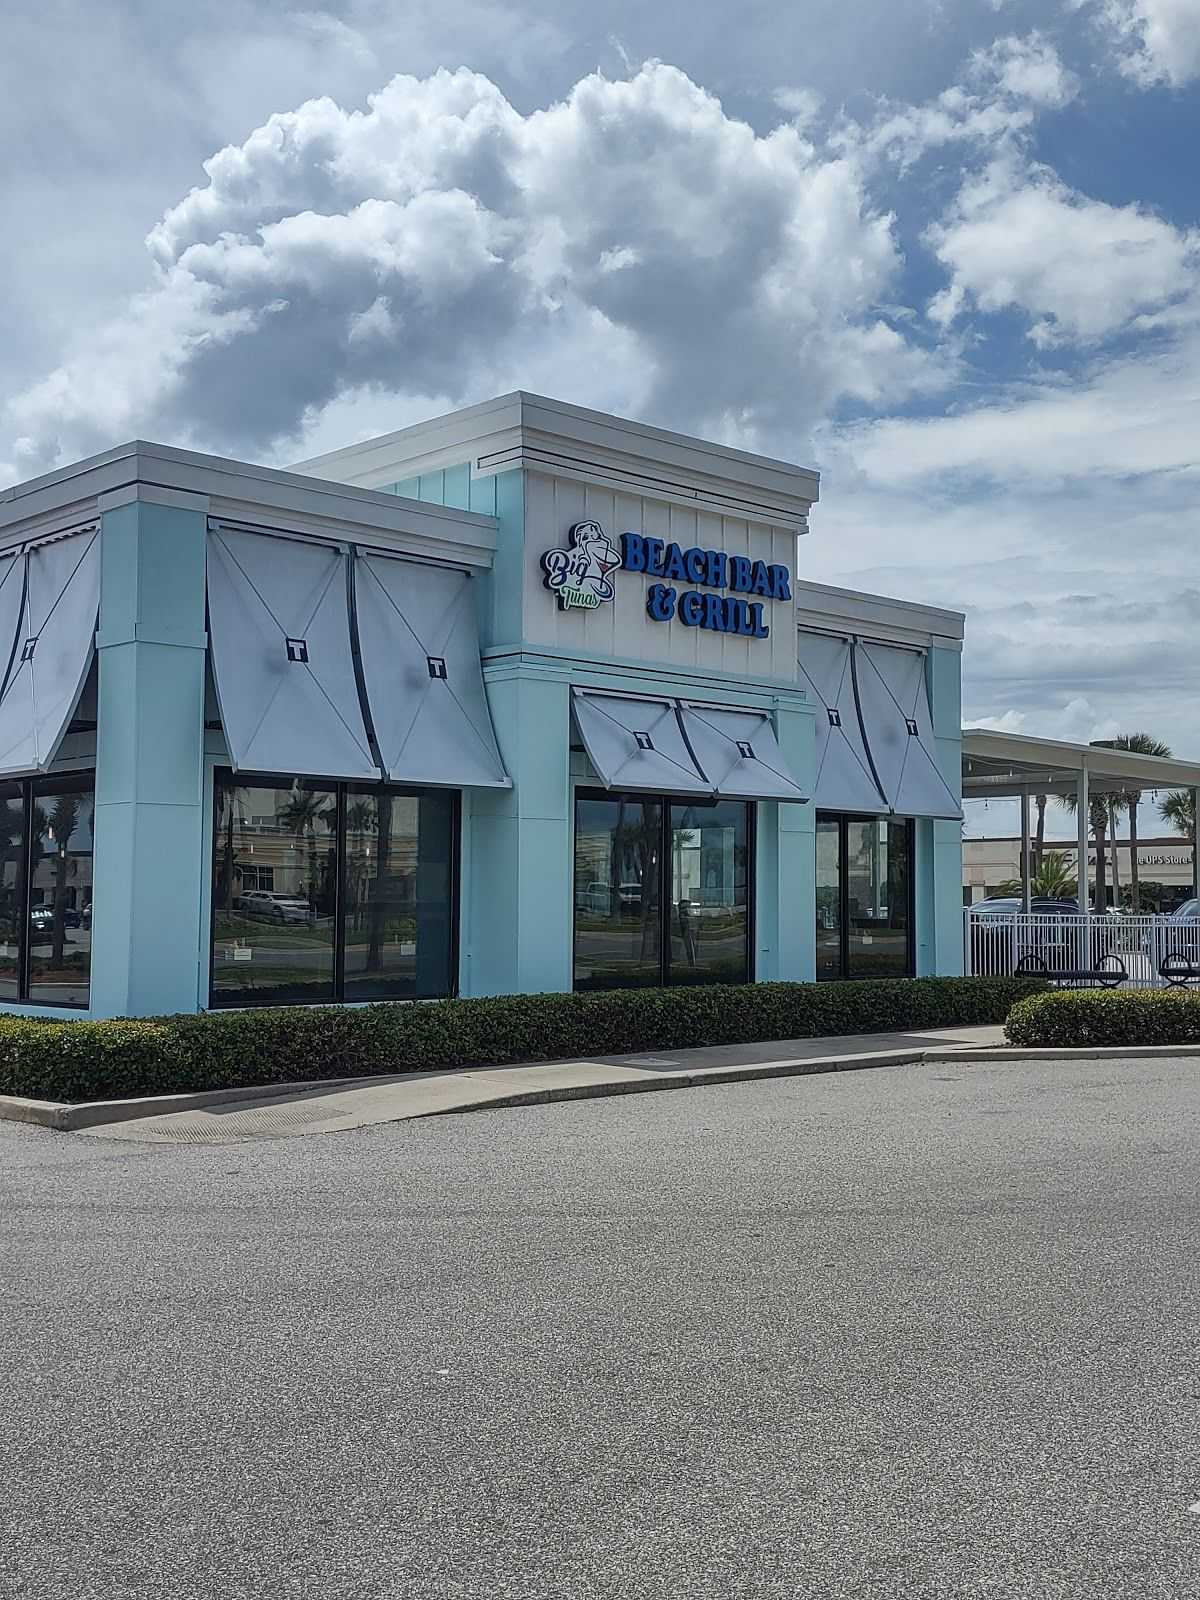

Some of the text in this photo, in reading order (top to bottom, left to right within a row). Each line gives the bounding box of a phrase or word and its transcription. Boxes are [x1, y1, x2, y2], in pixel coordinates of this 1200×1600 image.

[546, 551, 589, 585] Big
[620, 533, 792, 601] BEACH BAR
[560, 585, 599, 609] Tunas
[646, 583, 770, 639] & GRILL
[1146, 855, 1163, 865] UPS
[1165, 855, 1188, 865] Store
